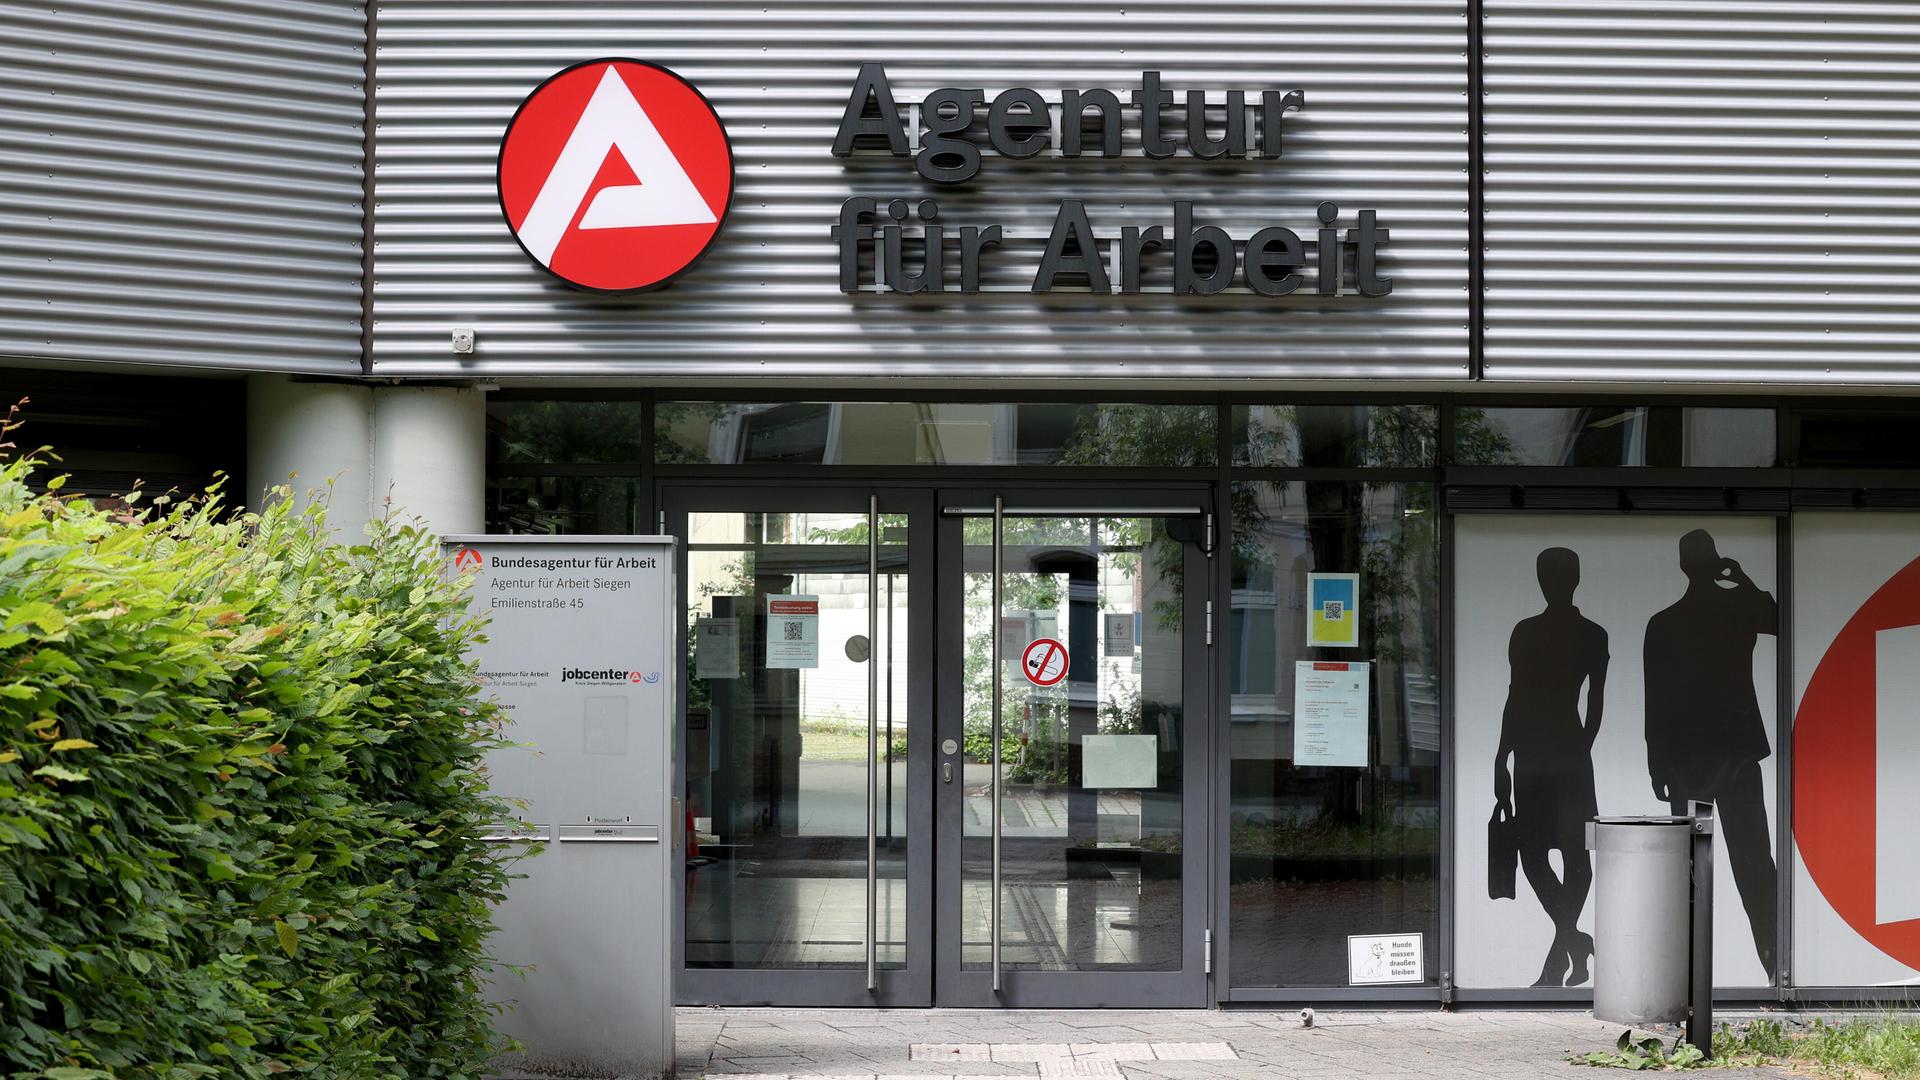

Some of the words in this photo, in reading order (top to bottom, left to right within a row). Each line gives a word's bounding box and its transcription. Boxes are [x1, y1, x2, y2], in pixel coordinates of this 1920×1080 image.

[831, 62, 1304, 184] Agentur
[831, 196, 1002, 294] für
[1031, 199, 1393, 296] Arbeit
[491, 556, 591, 571] Bundesagentur
[594, 556, 613, 568] für
[616, 556, 656, 568] Arbeit
[491, 577, 535, 590] Agentur
[538, 577, 554, 589] für
[556, 577, 590, 589] Arbeit
[593, 577, 631, 591] Siegen
[491, 598, 566, 608] Emilienstraße
[569, 598, 584, 608] 45
[561, 667, 629, 682] jobcenter
